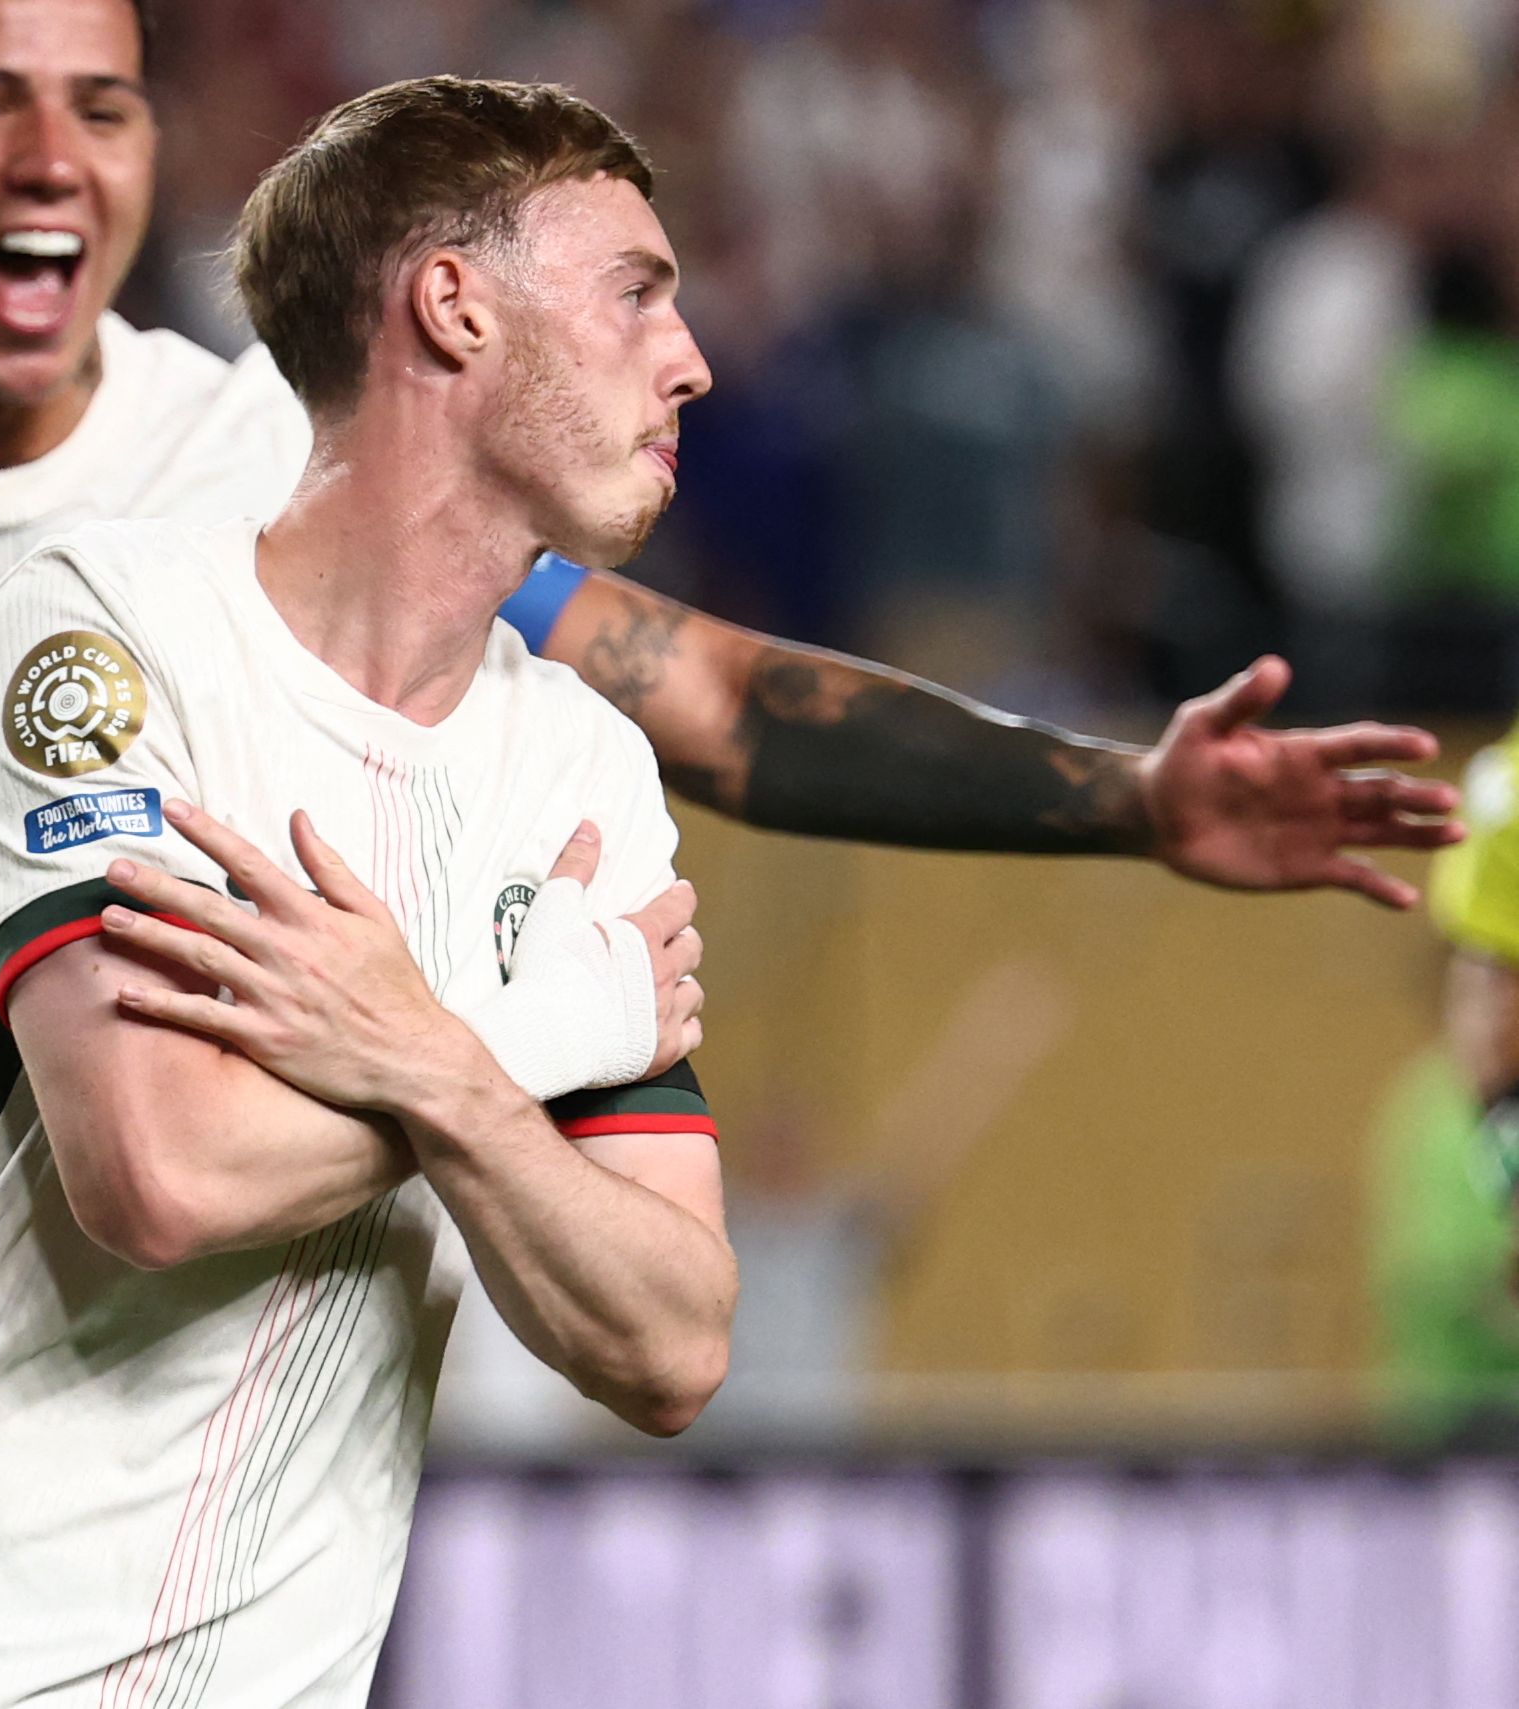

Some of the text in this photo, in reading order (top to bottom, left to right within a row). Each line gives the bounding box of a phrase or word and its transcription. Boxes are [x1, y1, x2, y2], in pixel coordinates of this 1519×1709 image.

[14, 646, 132, 748] CLUB WORLD CUP 25 USA
[44, 741, 102, 767] FIFA
[37, 792, 147, 828] FOOTBALL UNITES
[117, 818, 146, 830] FIFA
[40, 813, 113, 850] the World
[499, 886, 534, 910] CHELS
